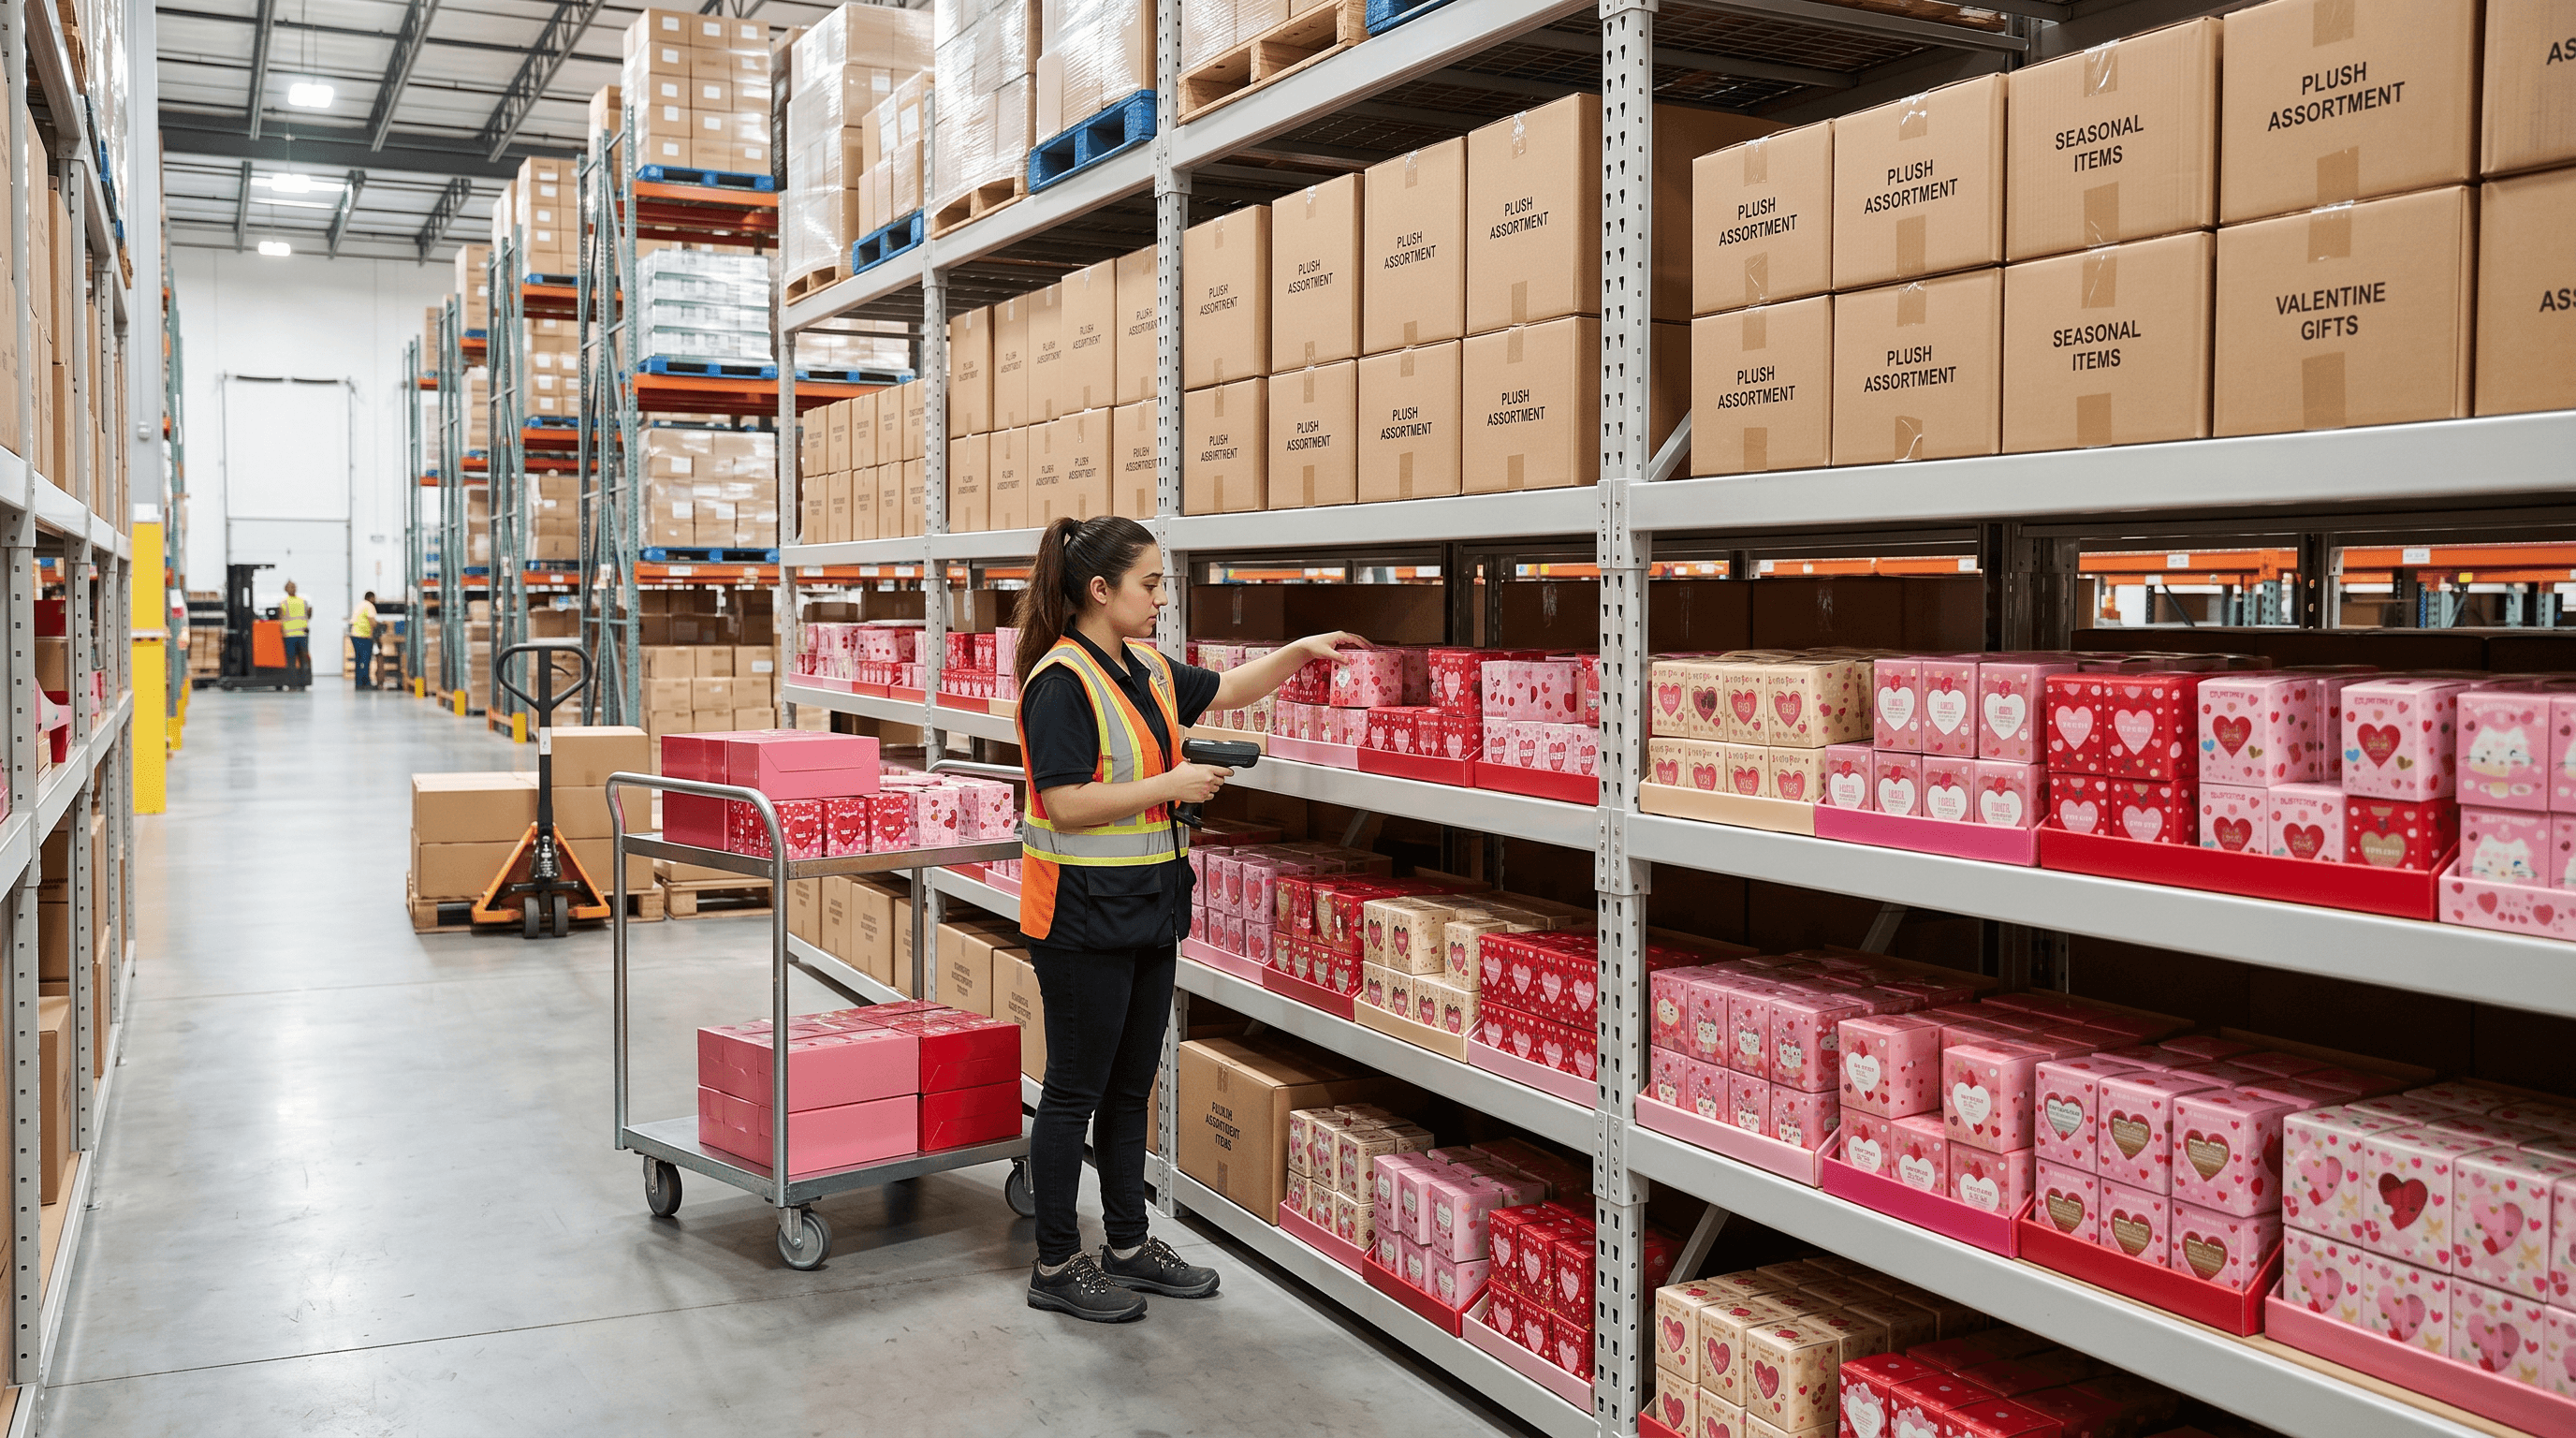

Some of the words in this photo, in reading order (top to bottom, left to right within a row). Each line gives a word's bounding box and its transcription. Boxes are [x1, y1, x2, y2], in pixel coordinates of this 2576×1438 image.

[2302, 62, 2366, 95] PLUSH
[2267, 81, 2405, 131] ASSORTMENT
[2055, 115, 2144, 150] SEASONAL
[2074, 145, 2123, 172] ITEMS
[1887, 160, 1934, 186] PLUSH
[1504, 197, 1533, 217] PLUSH
[1865, 179, 1958, 214] ASSORTMENT
[1737, 198, 1777, 221] PLUSH
[1489, 212, 1549, 240] ASSORTMENT
[1719, 214, 1797, 246] ASSORTMENT
[1397, 231, 1423, 249] PLUSH
[1298, 259, 1321, 275] PLUSH
[1383, 245, 1437, 270] ASSORTMENT
[2276, 282, 2386, 315] VALENTINE
[2539, 288, 2576, 313] ASS
[2054, 320, 2142, 347] SEASONAL
[2302, 315, 2359, 341] GIFTS
[1887, 345, 1932, 367] PLUSH
[2072, 347, 2121, 371] ITEMS
[1737, 366, 1775, 386] PLUSH
[1864, 366, 1957, 393] ASSORTMENT
[1501, 389, 1530, 406] PLUSH
[1717, 386, 1796, 410] ASSORTMENT
[1392, 406, 1418, 421] PLUSH
[1486, 406, 1545, 427] ASSORTMENT
[1297, 420, 1319, 433] PLUSH
[1381, 422, 1433, 441] ASSORTMENT
